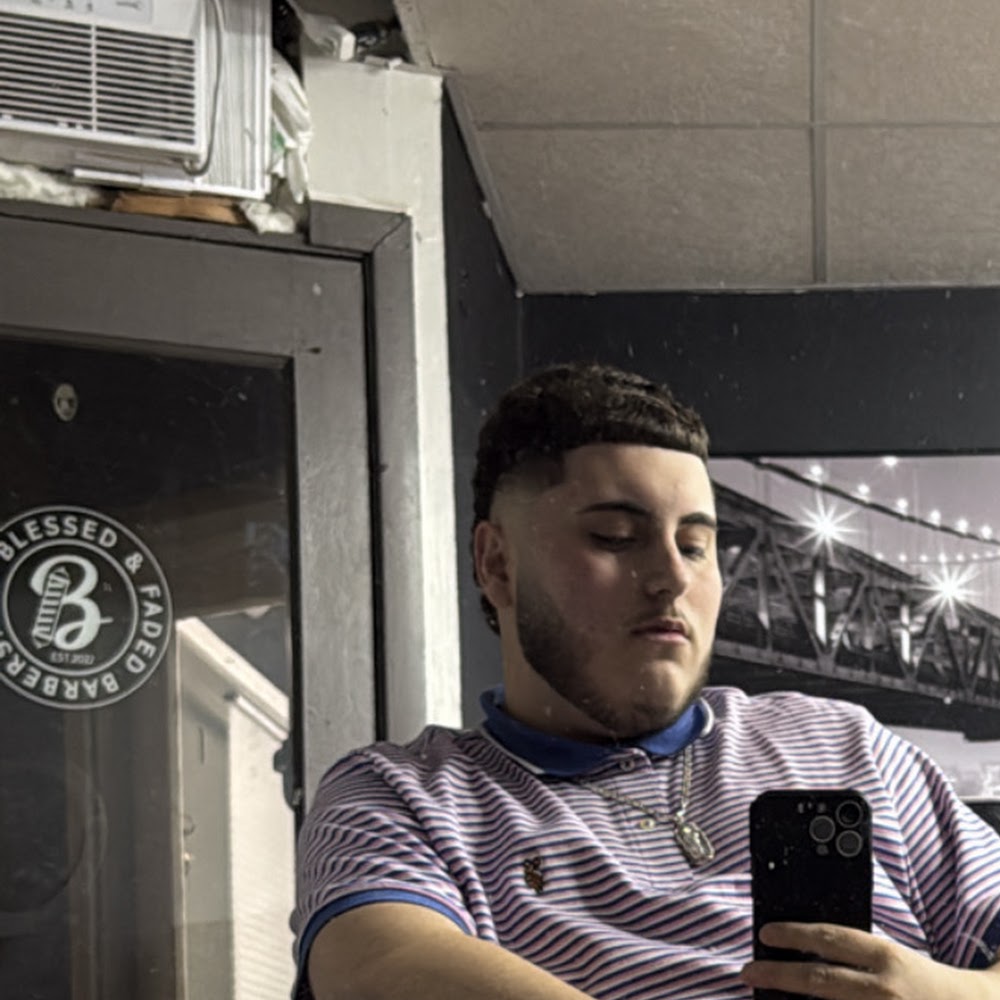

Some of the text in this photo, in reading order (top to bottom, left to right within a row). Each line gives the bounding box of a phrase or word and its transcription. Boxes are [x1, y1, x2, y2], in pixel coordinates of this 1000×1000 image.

[0, 515, 164, 700] BLESSED & FADED BARBERS
